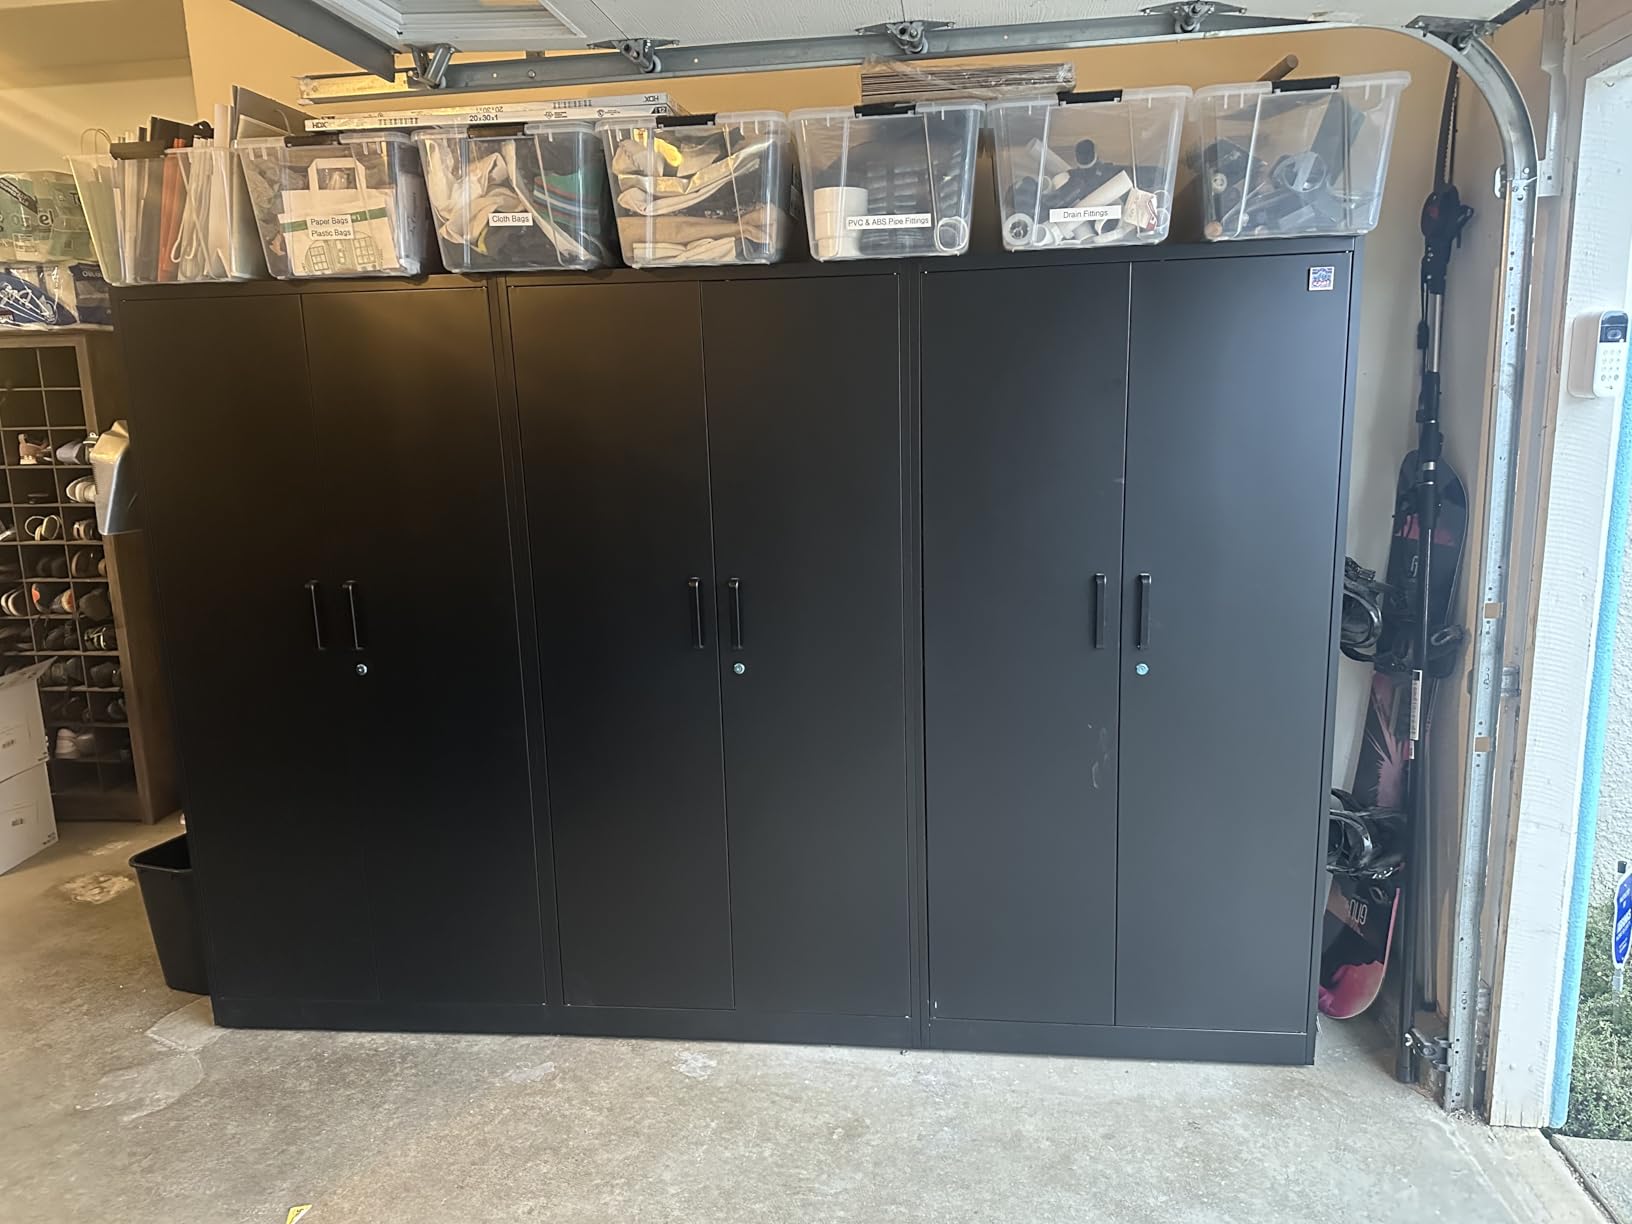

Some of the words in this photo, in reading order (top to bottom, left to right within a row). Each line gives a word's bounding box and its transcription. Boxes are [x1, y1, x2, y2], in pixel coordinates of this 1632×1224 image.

[312, 121, 328, 129] HDX
[491, 215, 510, 223] Cloth
[511, 215, 530, 223] Bags
[1063, 211, 1082, 219] Drain
[1083, 210, 1108, 218] Fittings
[310, 217, 330, 226] Paper
[331, 216, 349, 226] Bags
[848, 219, 864, 227] PVC
[872, 218, 887, 226] ABS
[888, 217, 903, 225] Pipe
[905, 216, 929, 225] Fittings
[311, 229, 334, 238] Plastic
[335, 228, 352, 238] Bags
